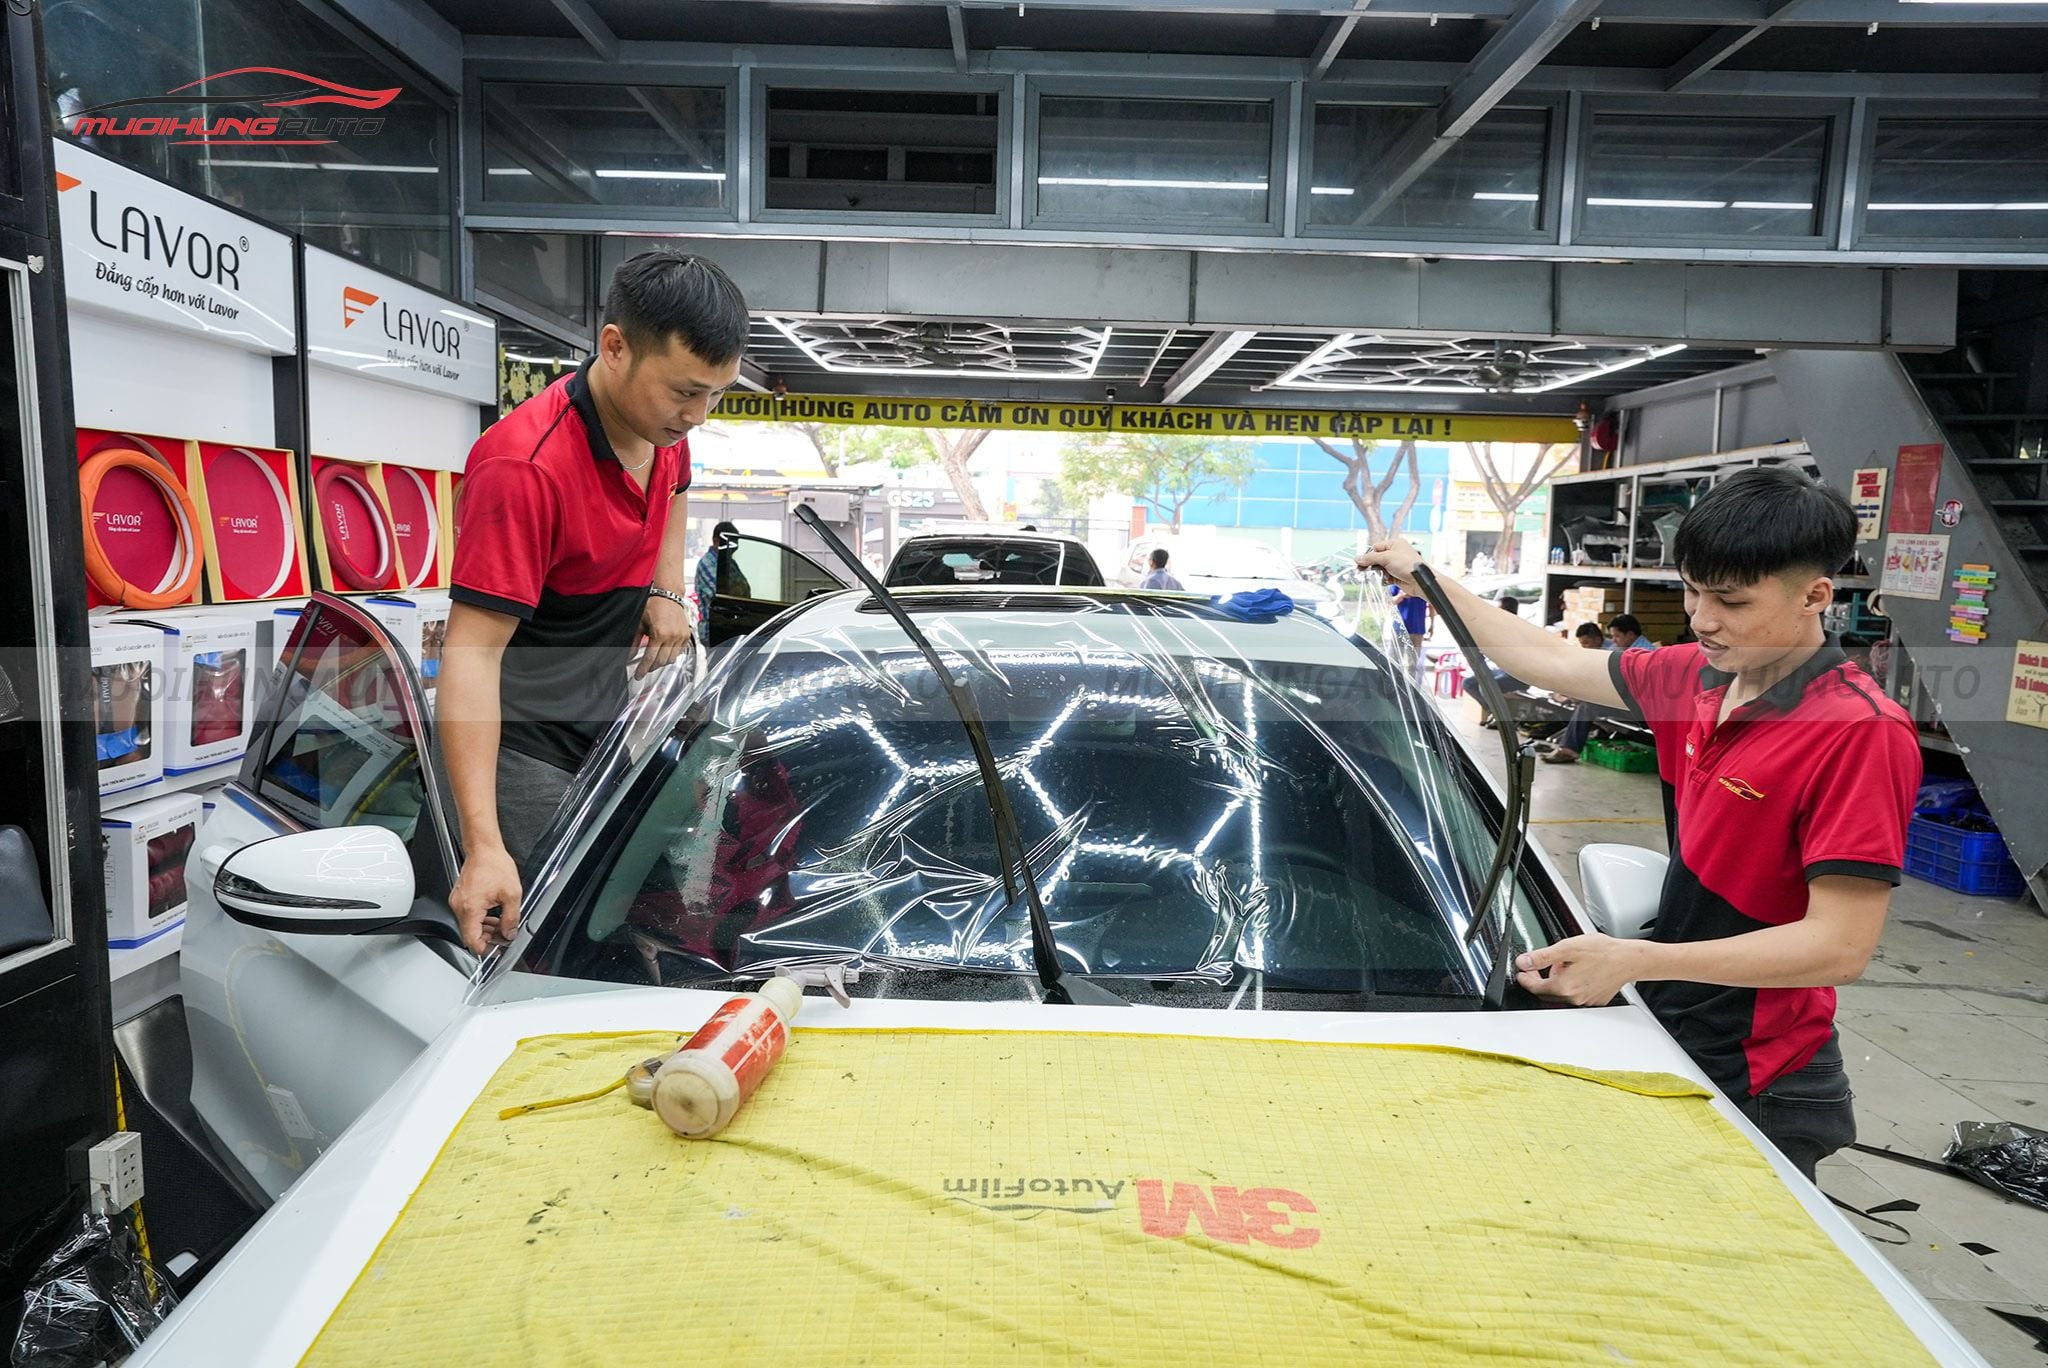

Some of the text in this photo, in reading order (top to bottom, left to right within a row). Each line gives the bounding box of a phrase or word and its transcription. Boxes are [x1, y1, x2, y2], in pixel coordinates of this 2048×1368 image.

[90, 190, 240, 292] LAVOR
[95, 262, 239, 320] Đẳng cấp hơn với Lavor
[383, 301, 460, 360] LAVOR
[780, 396, 854, 419] HÙNG
[863, 402, 931, 421] AUTO
[941, 400, 1003, 424] CẢM
[1012, 405, 1050, 425] ƠN
[1059, 406, 1111, 428] QUÝ
[1121, 408, 1212, 430] KHÁCH
[1221, 410, 1256, 431] VÀ
[1265, 413, 1320, 435] HẸN
[1330, 412, 1383, 437] GẶP
[1393, 417, 1433, 438] LẠI
[106, 513, 141, 526] LAVOR
[887, 490, 936, 508] GS25
[942, 1178, 1321, 1249] 3M AutoFilm
